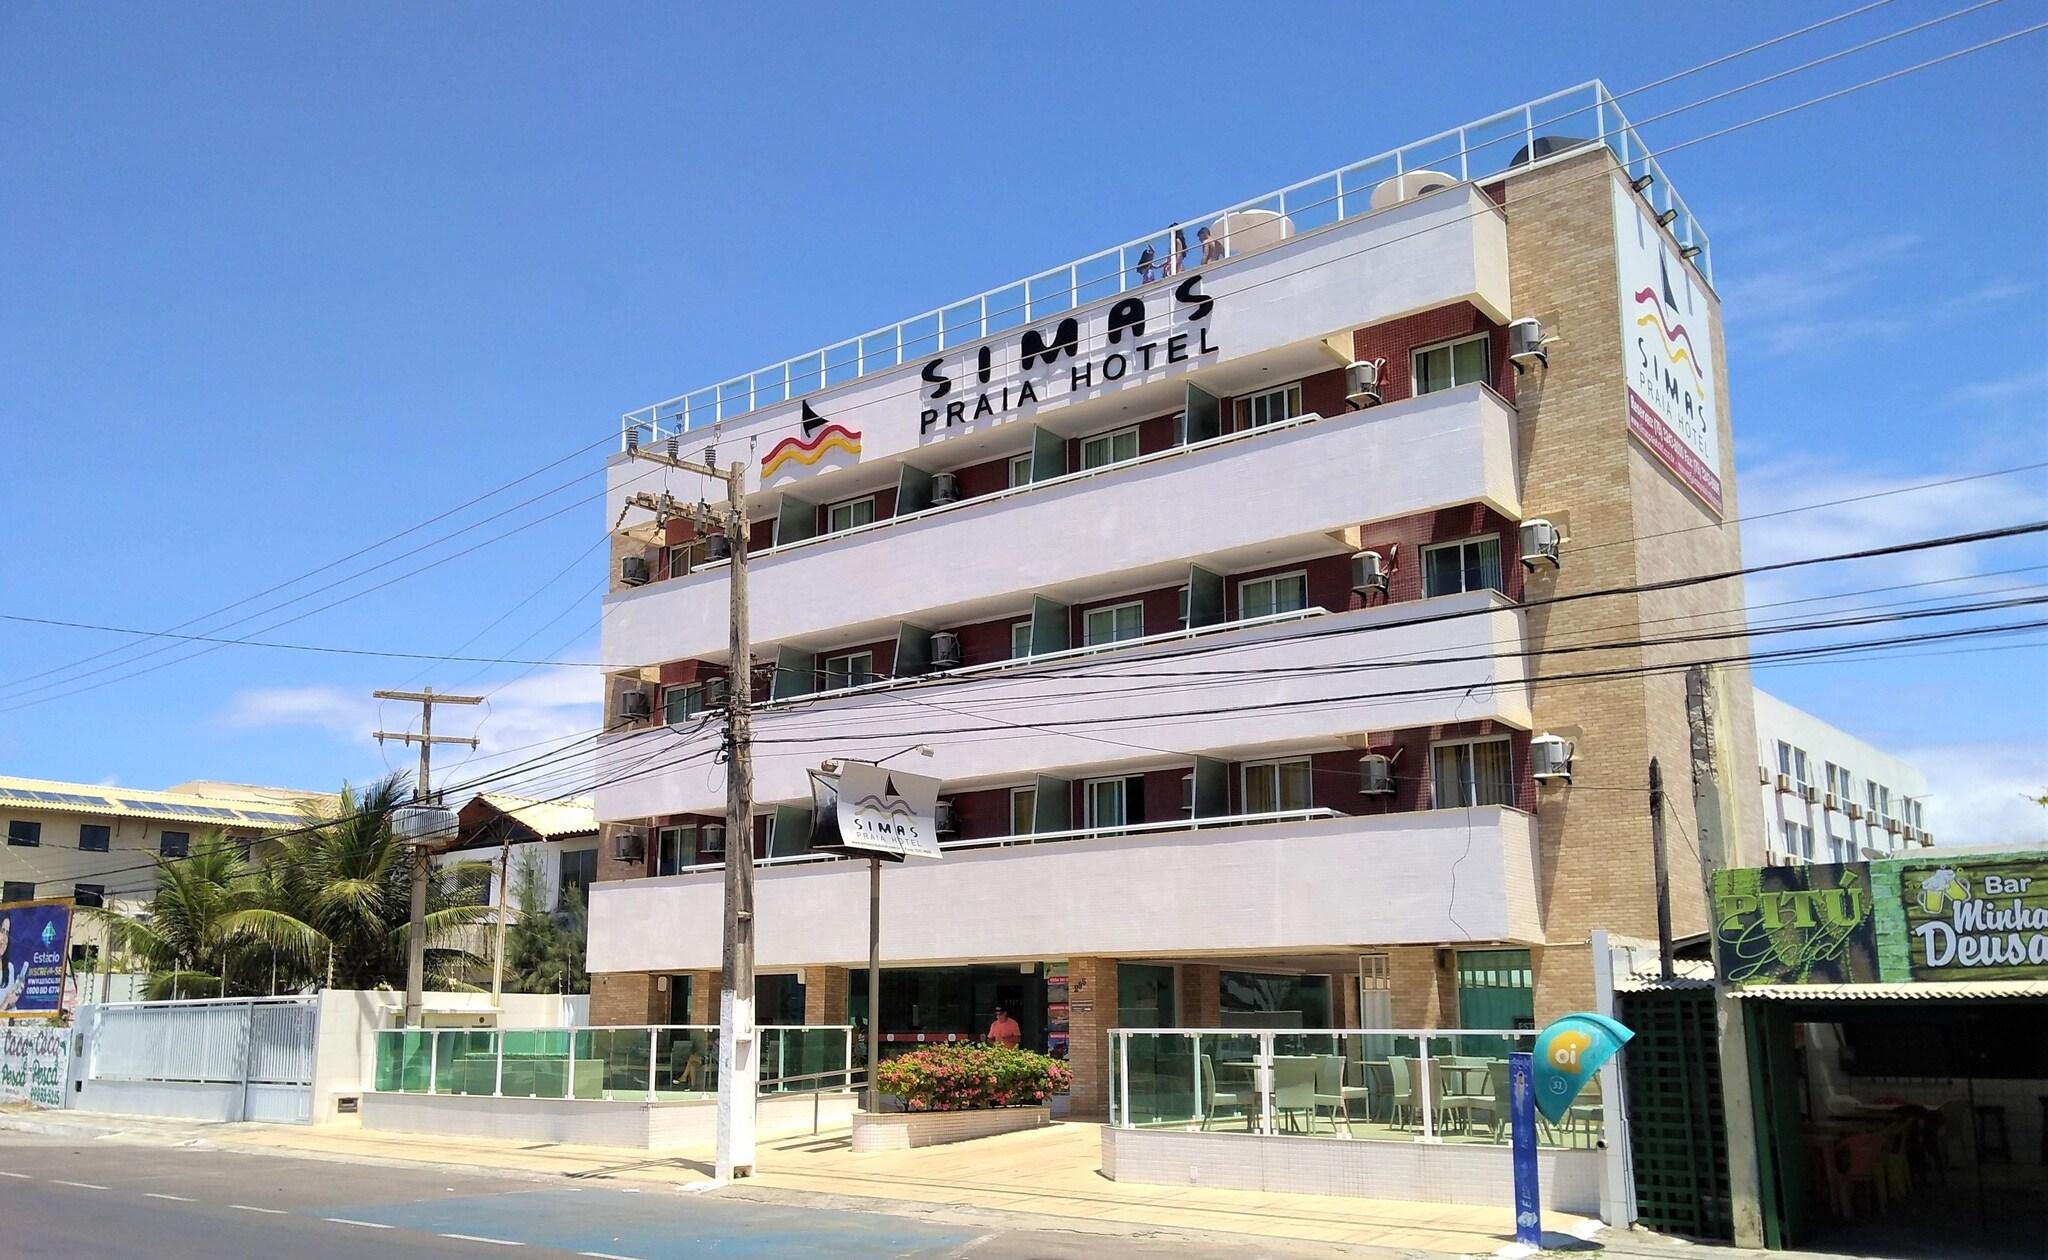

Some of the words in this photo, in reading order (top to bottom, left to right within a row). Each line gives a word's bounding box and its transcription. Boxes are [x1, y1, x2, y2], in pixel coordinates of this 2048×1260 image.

[921, 275, 1214, 399] SIMAS
[920, 380, 1038, 435] PRAIA
[1071, 327, 1219, 392] HOTEL
[1637, 336, 1707, 434] SIMAS
[1639, 370, 1673, 420] PRAIA
[1677, 411, 1710, 459] HOTEL
[853, 818, 919, 839] SIMAS
[856, 831, 886, 843] PRAIA
[891, 836, 922, 848] HOTEL
[1719, 870, 1864, 931] PITÚ
[1984, 876, 2032, 894] Bar
[1952, 898, 2048, 934] Minha
[1717, 909, 1861, 982] Gold
[1914, 921, 2048, 968] Deusa
[1555, 1042, 1577, 1065] oi
